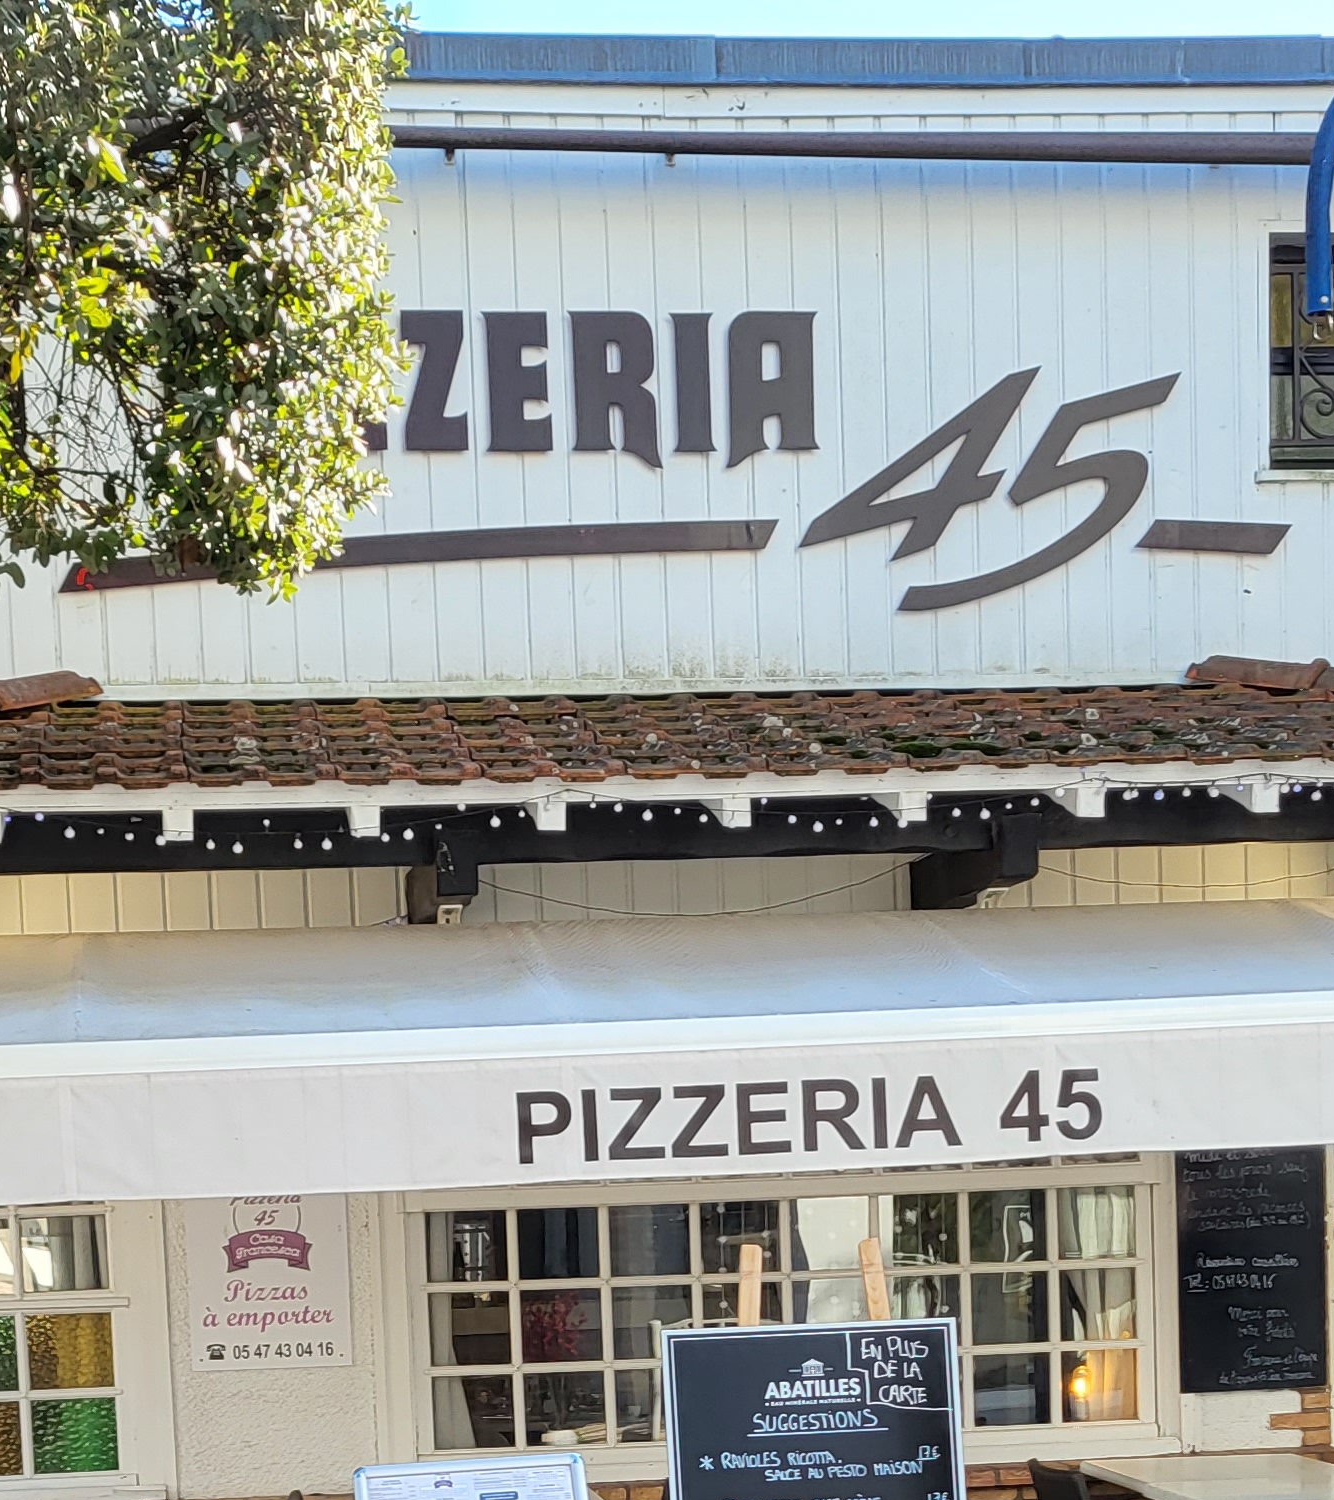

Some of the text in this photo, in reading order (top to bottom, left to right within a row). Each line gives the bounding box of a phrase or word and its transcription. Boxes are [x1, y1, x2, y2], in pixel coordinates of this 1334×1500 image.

[363, 309, 821, 468] ZERIA
[797, 365, 1180, 612] 45
[516, 1068, 1103, 1165] PIZZERIA 45
[254, 1209, 279, 1226] 45
[224, 1279, 308, 1302] Pizzas
[202, 1305, 335, 1333] à emporter
[232, 1341, 334, 1360] 05 47 43 04 16
[886, 1335, 929, 1358] PLUS
[873, 1360, 924, 1381] DE LA
[764, 1378, 862, 1400] ABATILLES
[878, 1384, 928, 1405] CARTE
[765, 1469, 803, 1482] SAUCE
[827, 1466, 867, 1478] PESTO
